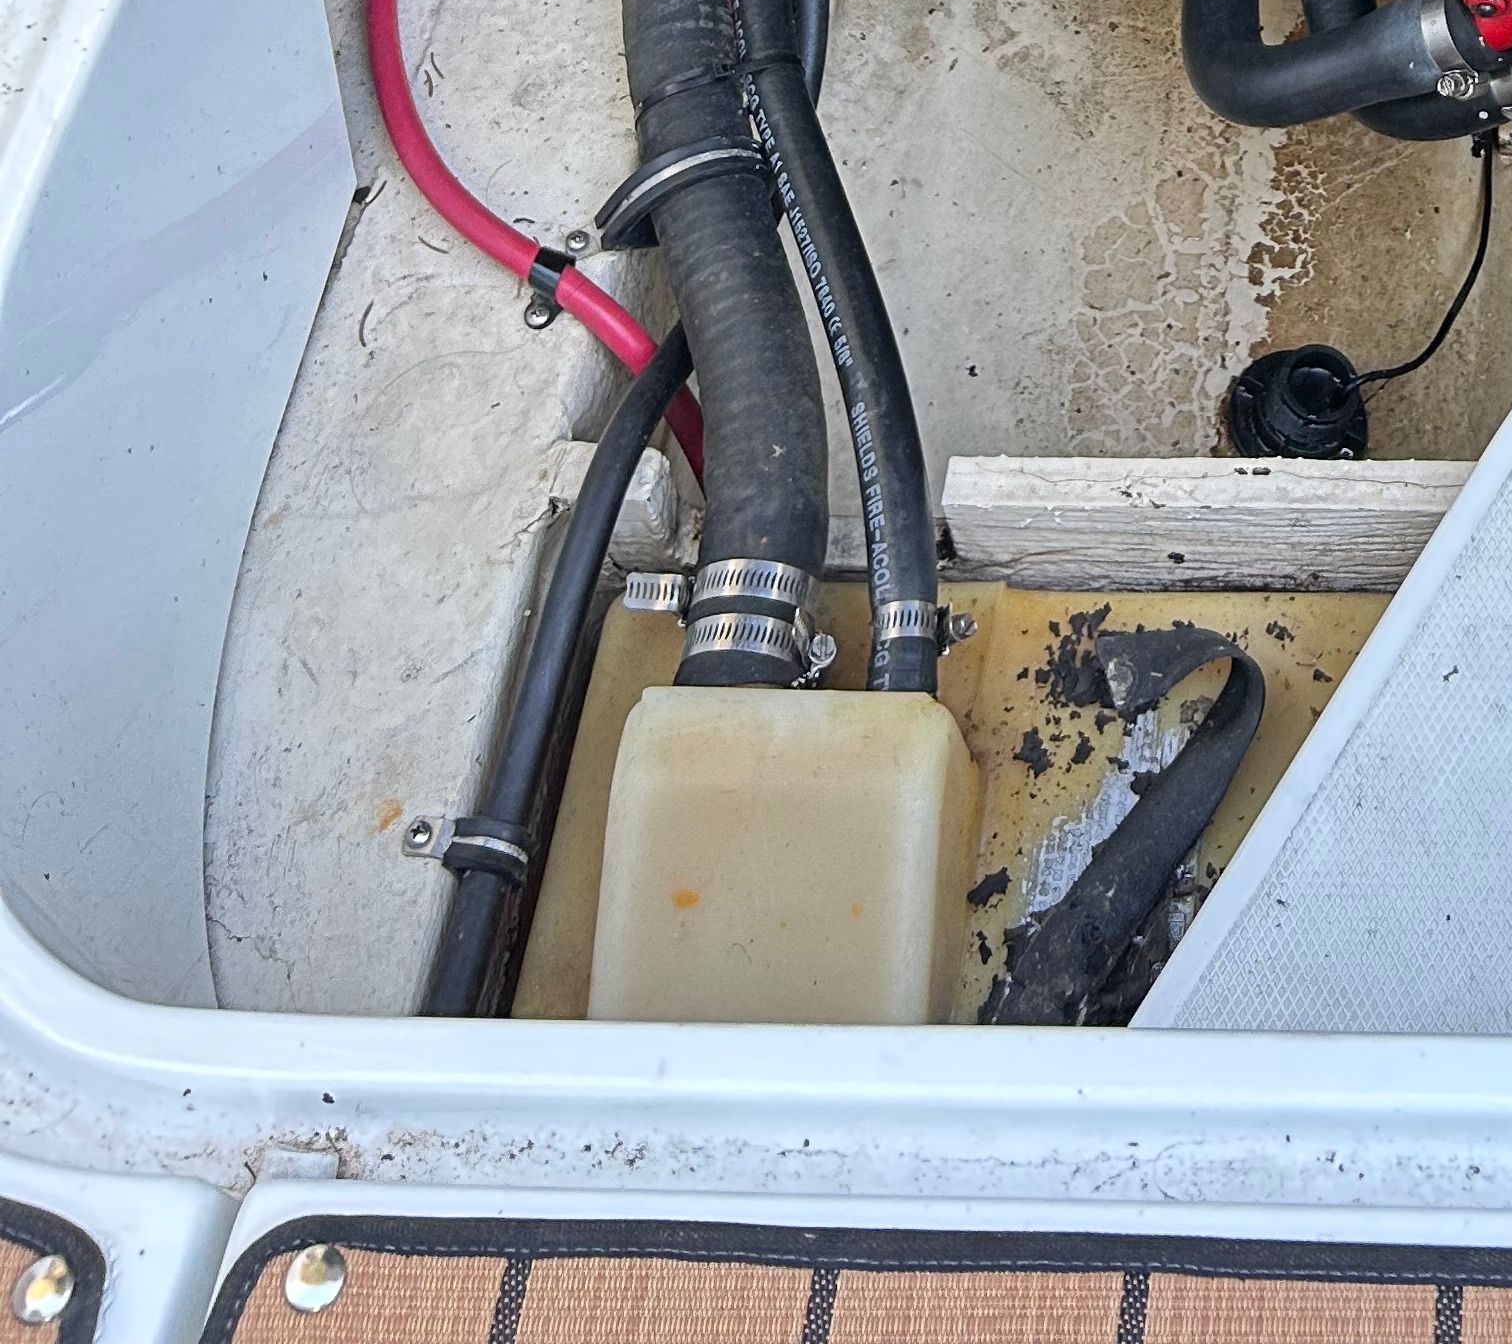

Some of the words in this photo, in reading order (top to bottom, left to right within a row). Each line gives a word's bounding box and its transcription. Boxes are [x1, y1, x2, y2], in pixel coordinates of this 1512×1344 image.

[753, 110, 779, 152] TYPE
[768, 152, 786, 172] A1
[774, 173, 798, 207] SAE
[812, 275, 837, 317] 7840
[849, 401, 880, 482] SHIELDS
[863, 483, 890, 601] FIRE-ACOL
